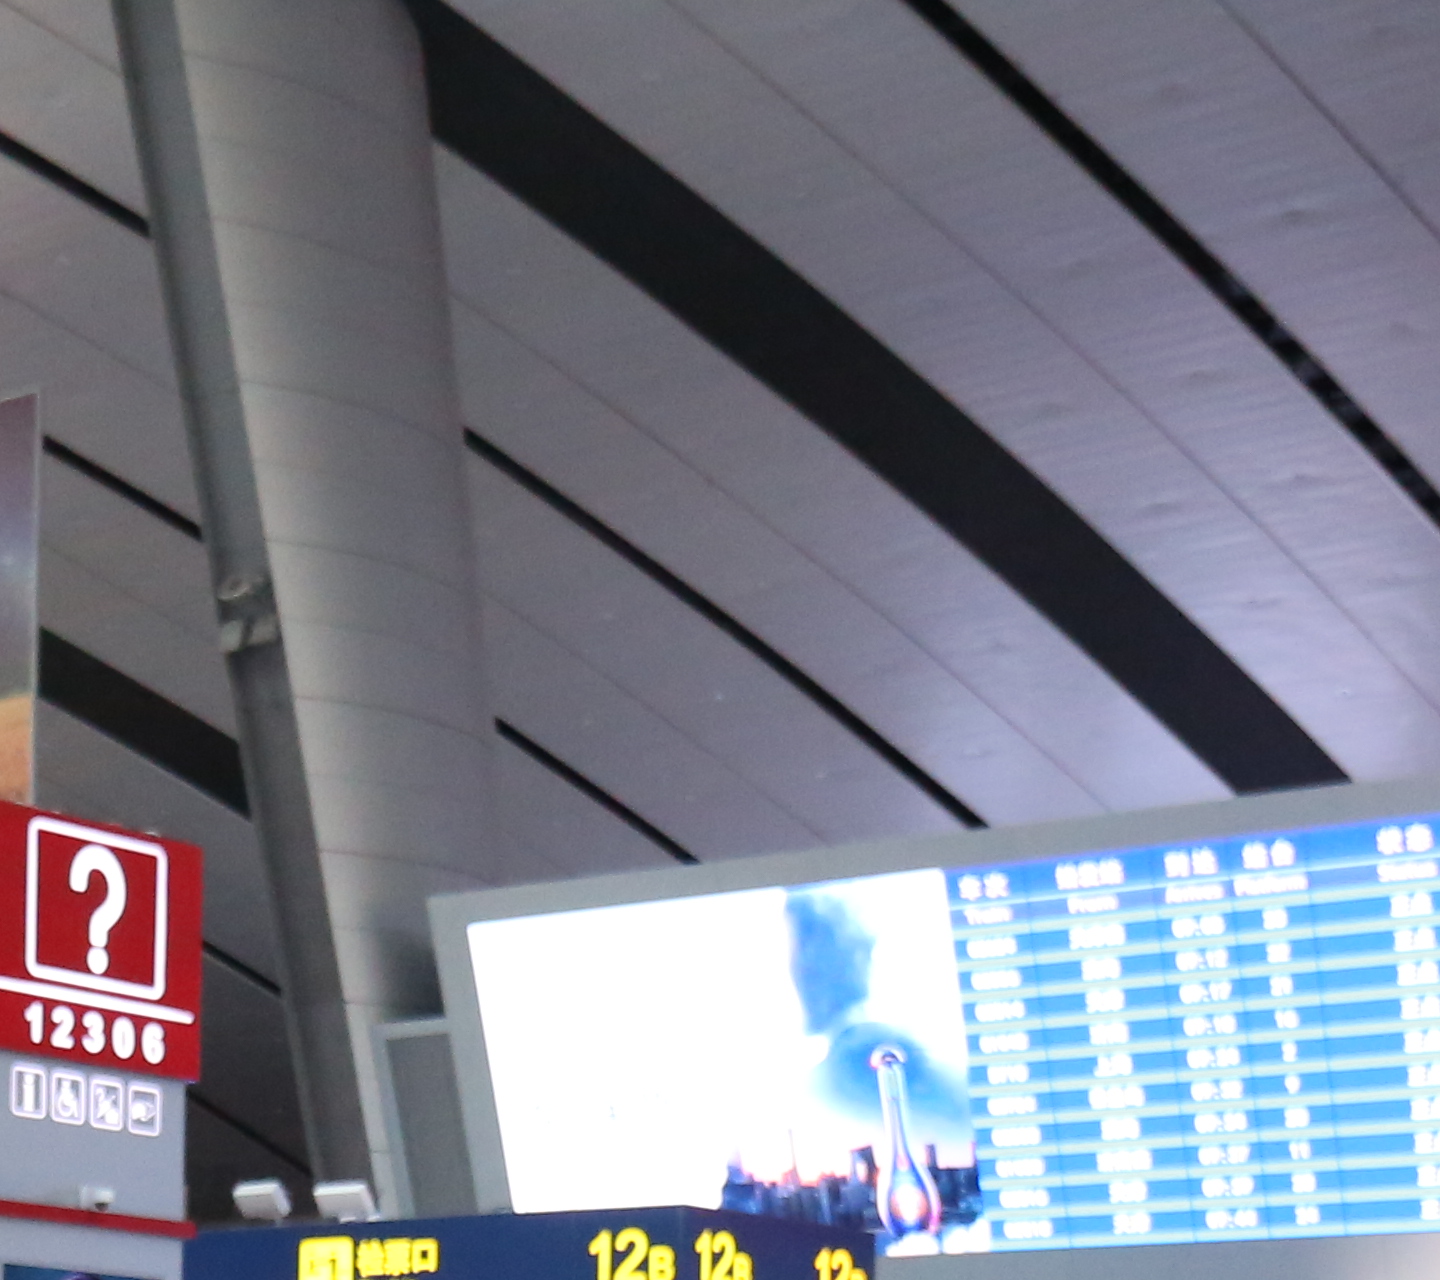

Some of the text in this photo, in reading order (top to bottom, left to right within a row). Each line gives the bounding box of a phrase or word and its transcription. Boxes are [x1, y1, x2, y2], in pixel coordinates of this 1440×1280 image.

[26, 997, 169, 1064] 12306
[356, 1238, 438, 1278] 检票口
